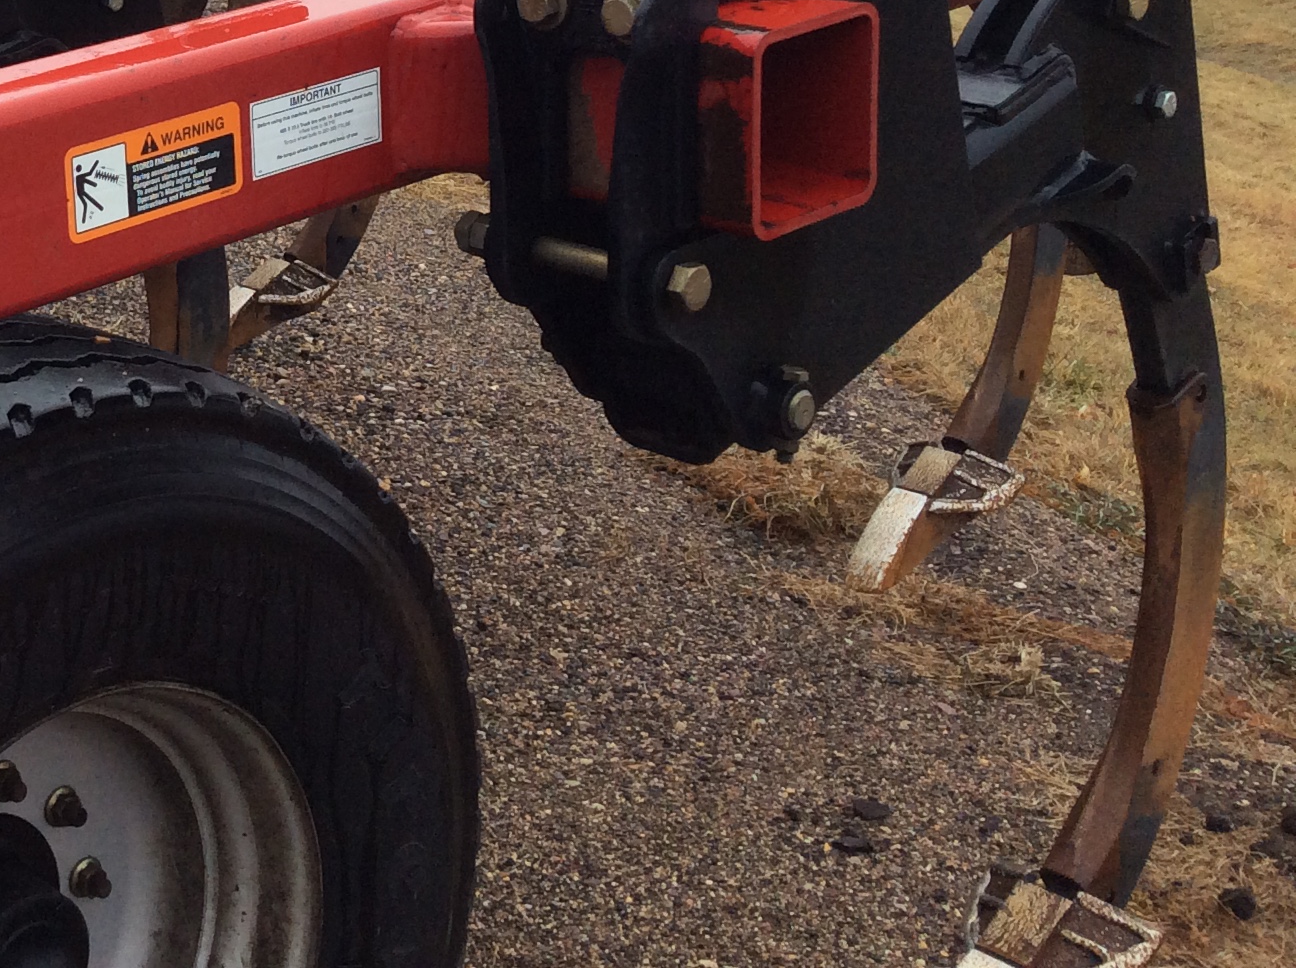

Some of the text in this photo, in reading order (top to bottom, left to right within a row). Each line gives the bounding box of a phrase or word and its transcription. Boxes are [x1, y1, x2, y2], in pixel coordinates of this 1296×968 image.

[289, 83, 342, 106] IMPORTANT
[161, 116, 225, 147] WARNING
[133, 150, 221, 183] Spring assemblies have potentially
[133, 177, 161, 191] dangerous
[162, 171, 178, 181] stored
[144, 185, 158, 194] avoid
[159, 180, 175, 190] bodily
[193, 171, 204, 179] read
[205, 168, 217, 176] your
[165, 185, 184, 195] Manual
[193, 176, 213, 186] Service
[137, 197, 168, 212] Instructions
[169, 194, 179, 202] and
